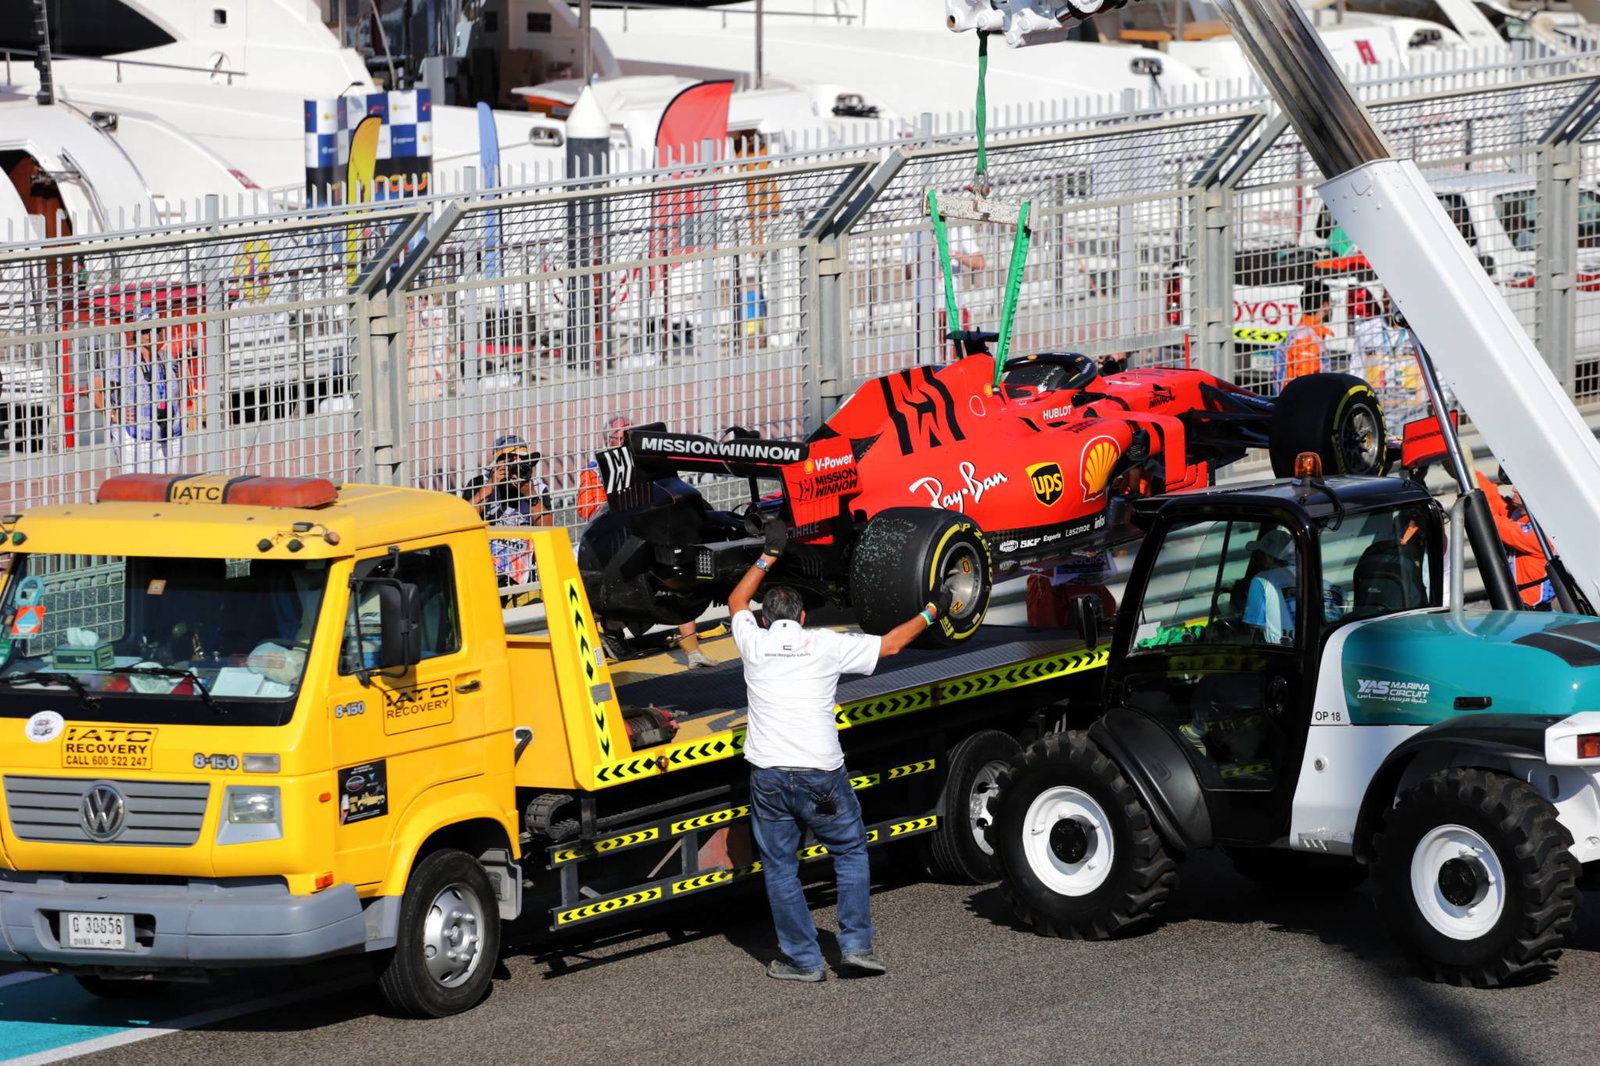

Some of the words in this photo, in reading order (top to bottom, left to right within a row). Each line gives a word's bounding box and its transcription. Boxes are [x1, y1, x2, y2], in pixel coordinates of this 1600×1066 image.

[1233, 300, 1299, 326] OYOT
[1042, 405, 1073, 420] HUBLOT
[815, 453, 853, 472] V-Power
[815, 467, 858, 487] MISSION
[173, 486, 220, 501] IATC
[815, 478, 858, 498] WINNOW
[1020, 537, 1041, 549] SKF
[1357, 679, 1391, 695] YAS
[1391, 681, 1431, 691] MARINA
[1389, 688, 1430, 699] CIRCUIT
[386, 699, 449, 719] RECOVERY
[1315, 711, 1329, 721] OP
[1331, 711, 1341, 722] 18
[67, 728, 152, 743] IATC
[66, 743, 148, 755] RECOVERY
[66, 755, 90, 766] CALL
[92, 756, 109, 766] 600
[111, 757, 128, 767] 522
[131, 757, 148, 767] 247
